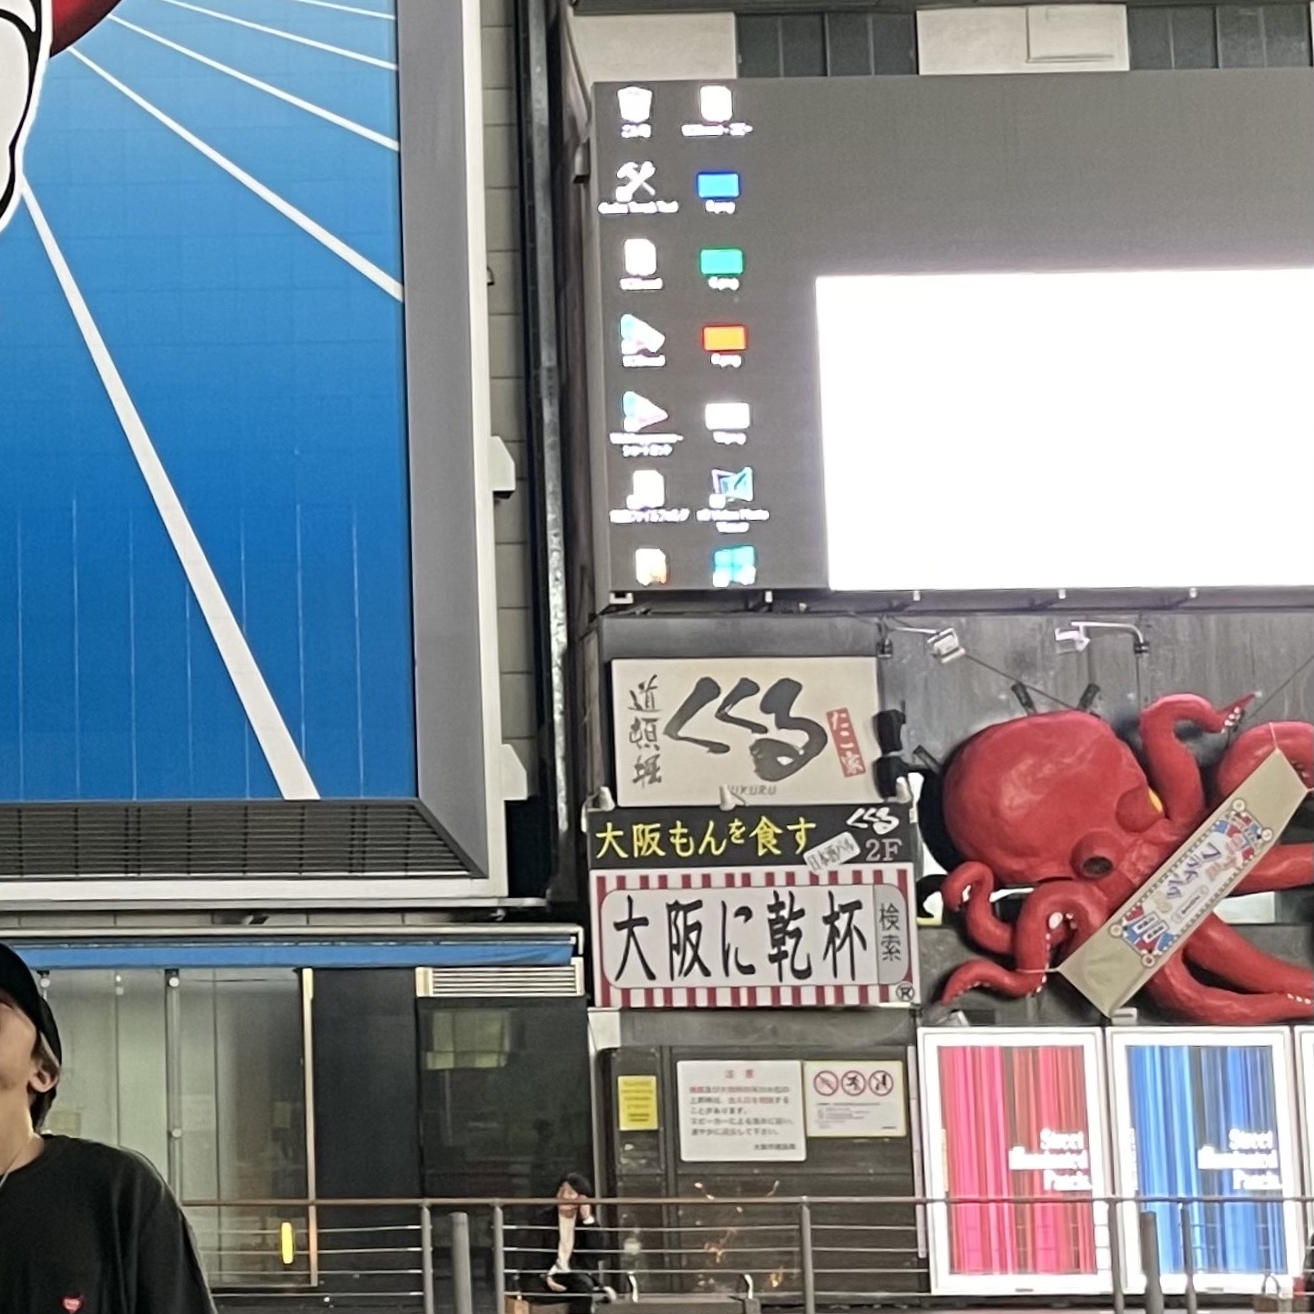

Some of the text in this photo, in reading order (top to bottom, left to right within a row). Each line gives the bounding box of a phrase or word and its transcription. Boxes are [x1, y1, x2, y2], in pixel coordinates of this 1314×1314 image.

[628, 673, 662, 788] 道頓堀
[595, 816, 816, 858] 大阪もんを食す
[866, 838, 902, 862] 2F
[613, 889, 867, 982] 大阪に乾杯
[878, 903, 902, 962] 検索
